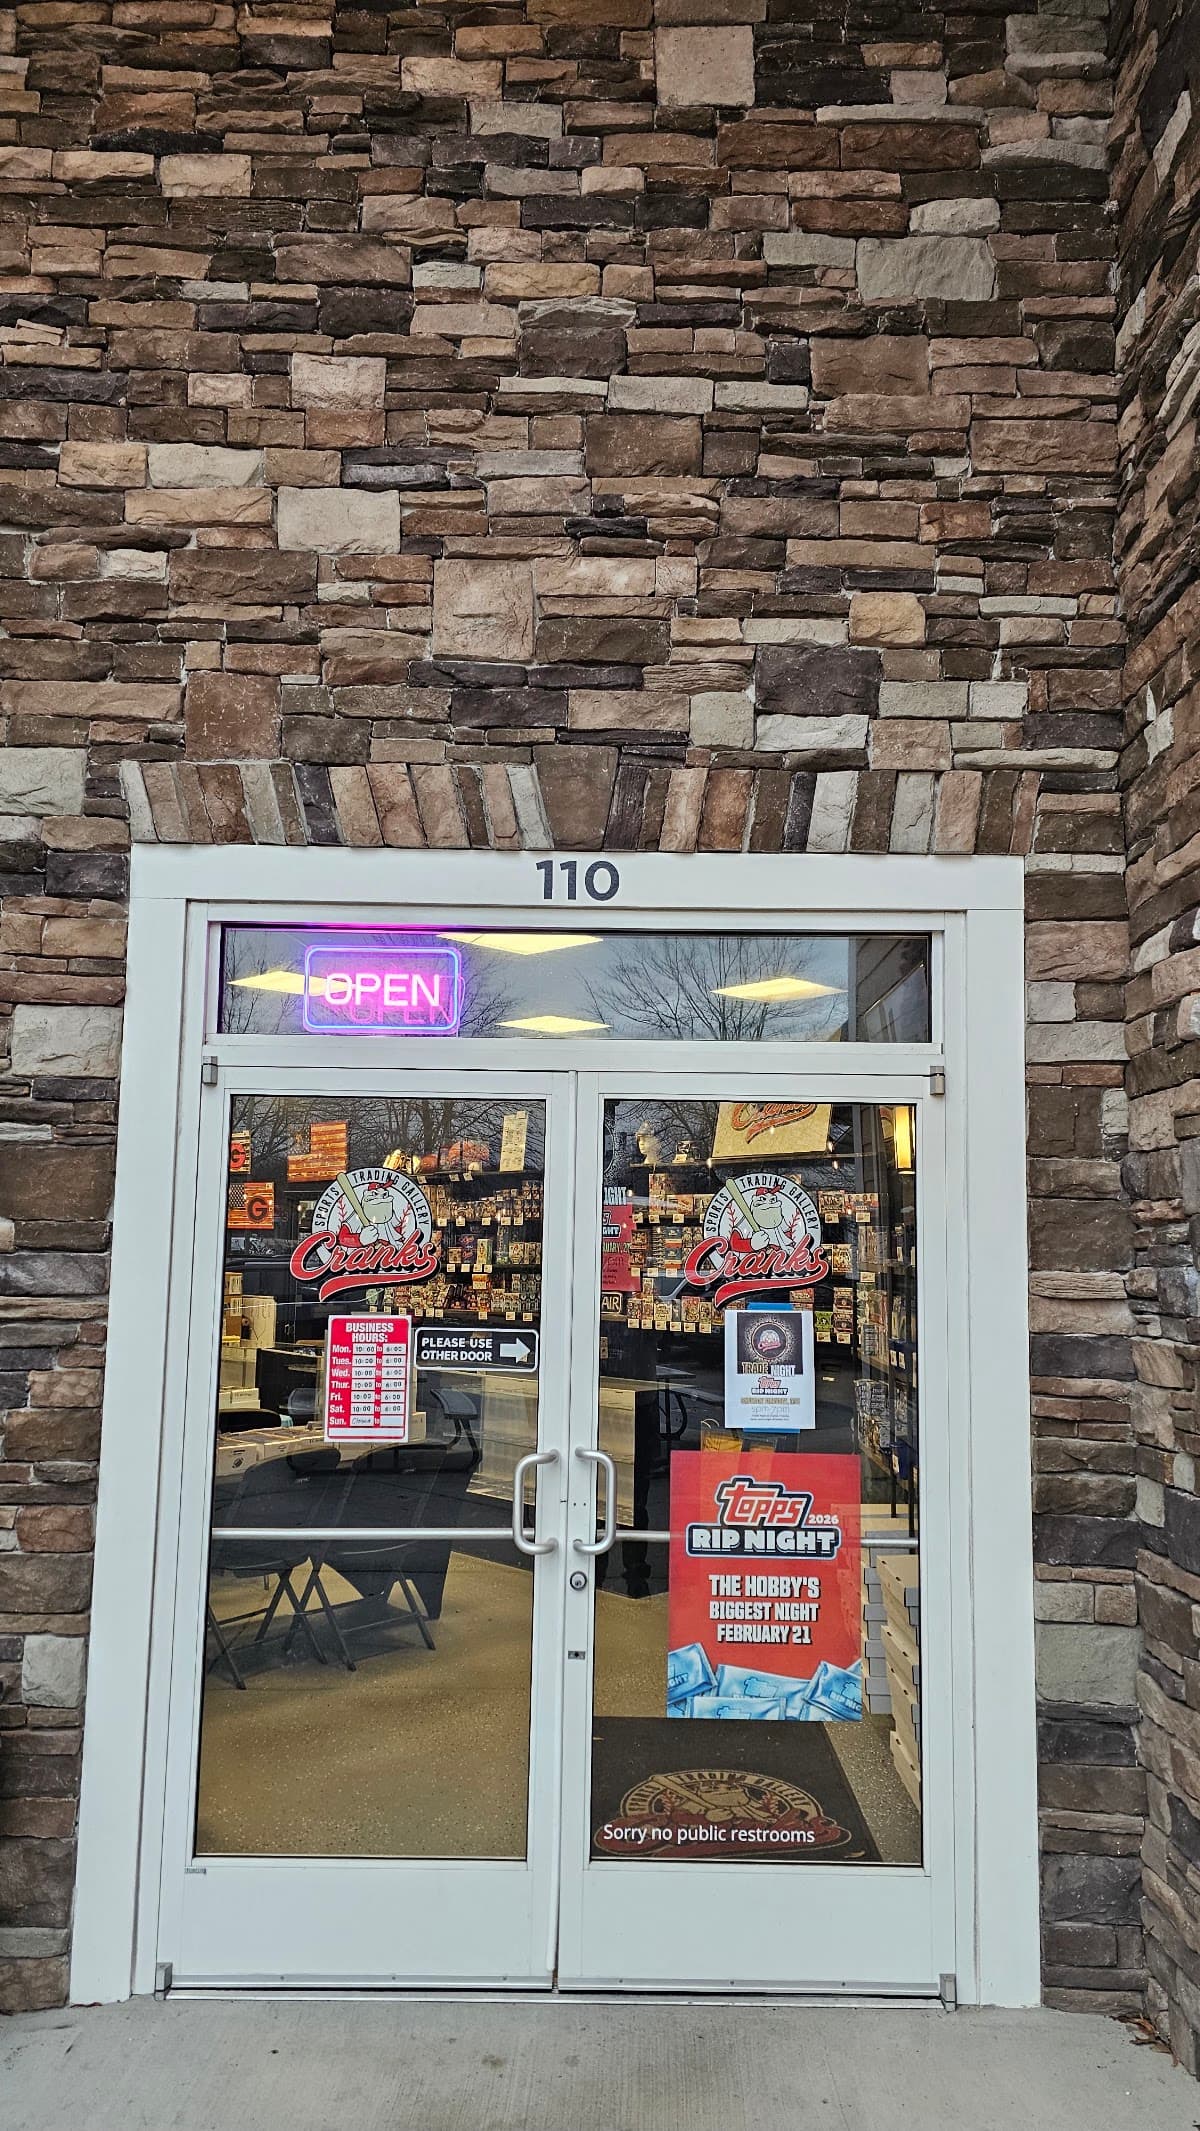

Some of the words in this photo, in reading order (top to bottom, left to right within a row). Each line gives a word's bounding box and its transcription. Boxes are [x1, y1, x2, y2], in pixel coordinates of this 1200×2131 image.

[535, 860, 620, 901] 110
[325, 972, 440, 1007] OPEN
[314, 1186, 340, 1227] SPORTS
[352, 1170, 400, 1185] TRADING
[401, 1181, 430, 1226] GALLERY
[706, 1192, 729, 1233] SPORTS
[740, 1178, 787, 1190] TRADING
[788, 1186, 820, 1230] GALLERY
[289, 1230, 438, 1284] Cranks
[684, 1233, 829, 1288] Cranks
[345, 1322, 394, 1333] BUSINESS
[351, 1332, 388, 1343] HOURS:
[421, 1337, 466, 1348] PLEASE
[469, 1338, 493, 1349] USE
[332, 1345, 352, 1353] Mon.
[421, 1350, 459, 1360] OTHER
[460, 1351, 492, 1362] DOOR
[332, 1357, 352, 1365] Tues.
[331, 1368, 351, 1377] Wed.
[741, 1361, 769, 1375] TRADE
[770, 1364, 796, 1377] NIGHT
[331, 1381, 350, 1389] Thur.
[330, 1392, 342, 1401] Fri.
[329, 1404, 345, 1413] Sat.
[329, 1417, 347, 1425] Sun.
[808, 1514, 839, 1525] 2026
[692, 1528, 741, 1551] RIP
[744, 1529, 836, 1554] NIGHT
[709, 1574, 742, 1597] THE
[745, 1575, 821, 1599] HOBBY'S
[709, 1600, 773, 1620] BIGGEST
[774, 1602, 820, 1622] NIGHT
[717, 1624, 790, 1643] FEBRUARY
[791, 1625, 812, 1644] 21
[603, 1824, 648, 1845] Sorry
[651, 1827, 674, 1841] no
[677, 1825, 727, 1844] public
[731, 1829, 815, 1844] restrooms
